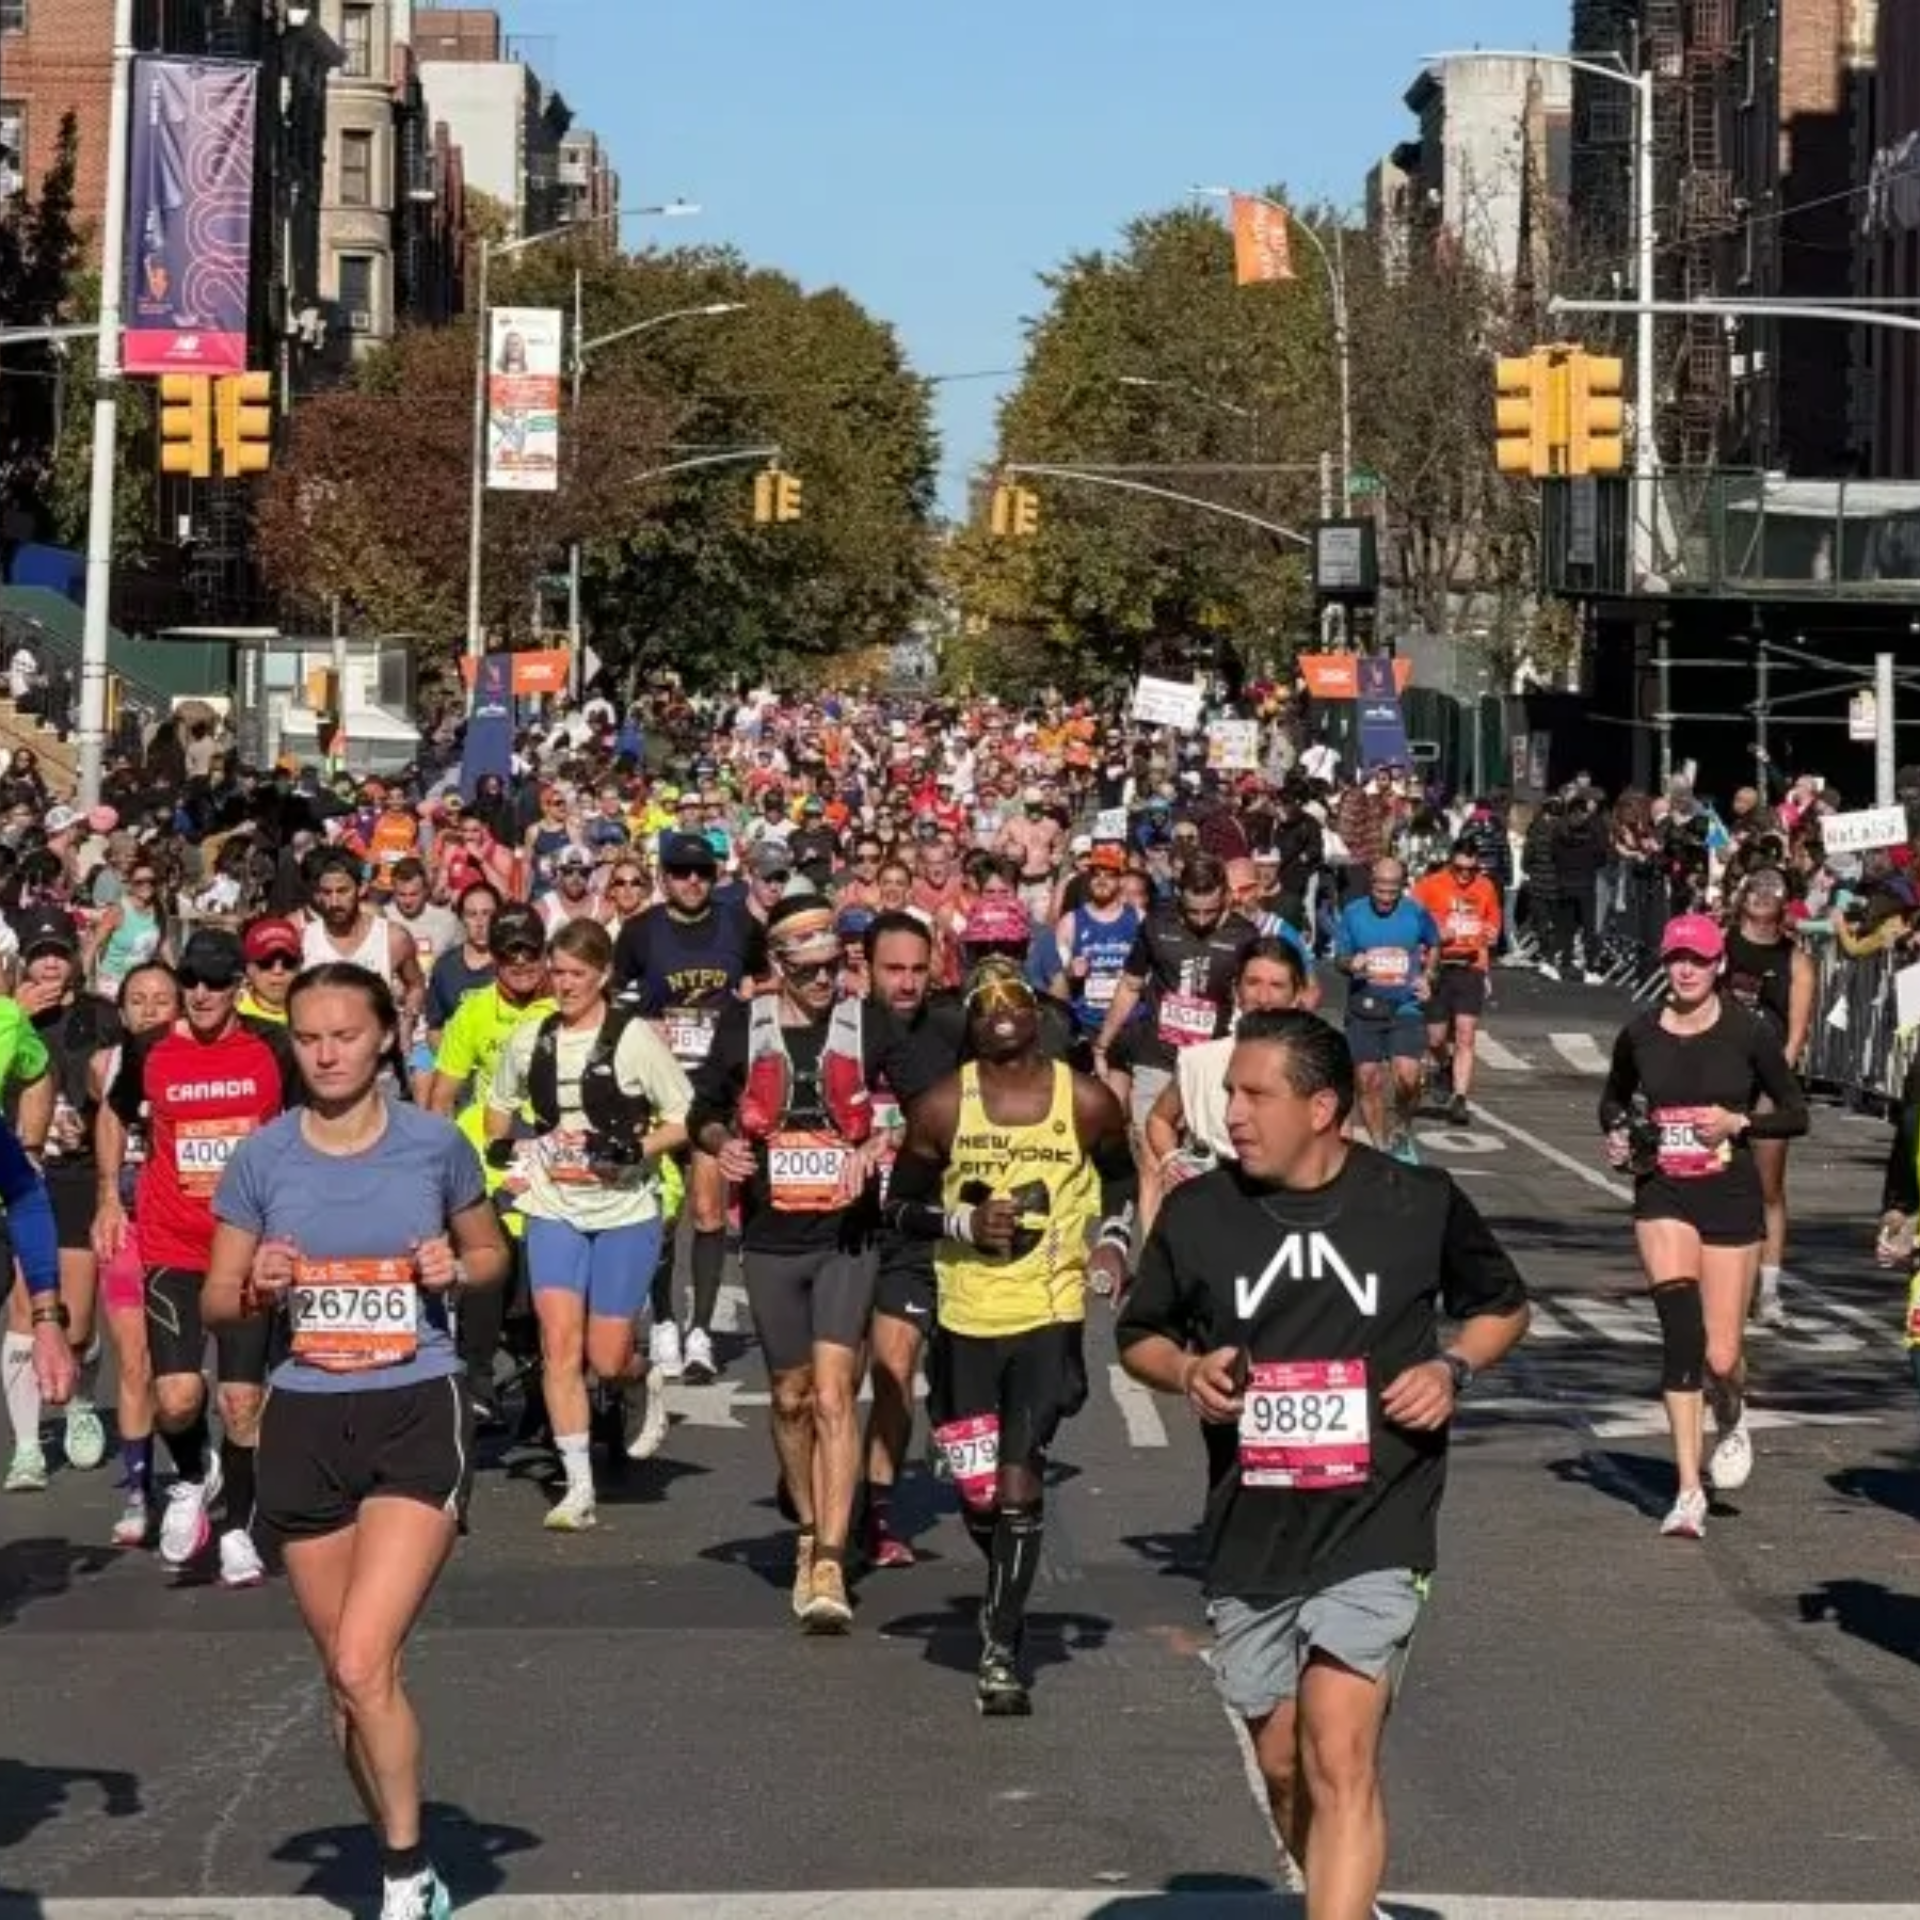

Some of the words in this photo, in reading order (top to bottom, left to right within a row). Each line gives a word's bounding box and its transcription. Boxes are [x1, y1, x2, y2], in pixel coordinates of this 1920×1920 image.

[663, 969, 728, 992] NYPD
[166, 1078, 256, 1102] CANADA
[181, 1138, 236, 1163] 400
[957, 1135, 1011, 1149] NEW
[1008, 1146, 1073, 1165] YORK
[959, 1160, 1010, 1175] CITY
[300, 1288, 407, 1321] 26766
[1253, 1394, 1348, 1433] 9882
